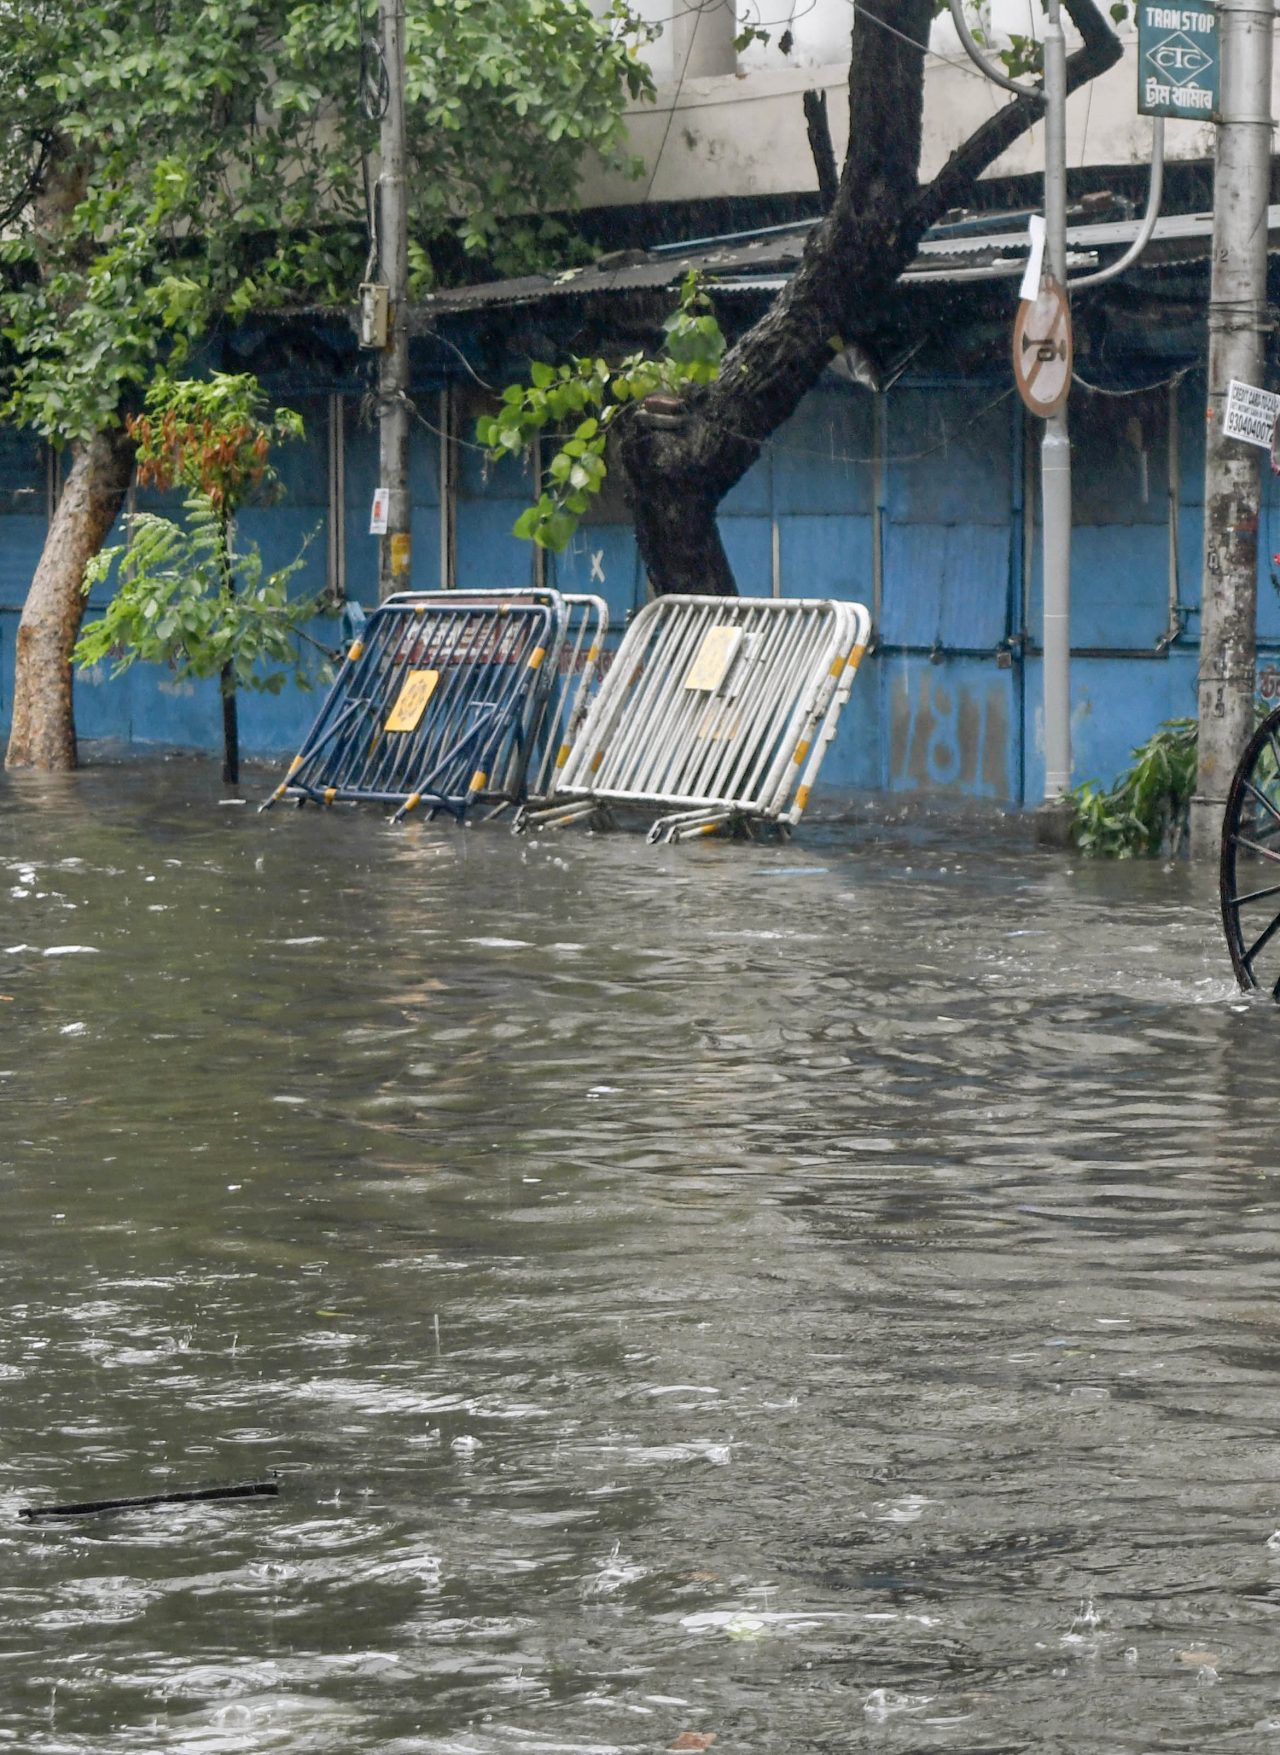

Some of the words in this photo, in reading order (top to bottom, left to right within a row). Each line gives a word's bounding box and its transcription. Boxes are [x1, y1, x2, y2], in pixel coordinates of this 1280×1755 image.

[1146, 7, 1180, 30] TRAM
[1181, 11, 1215, 34] STOP
[1157, 46, 1202, 70] CTC
[1145, 76, 1170, 108] ট্রাম
